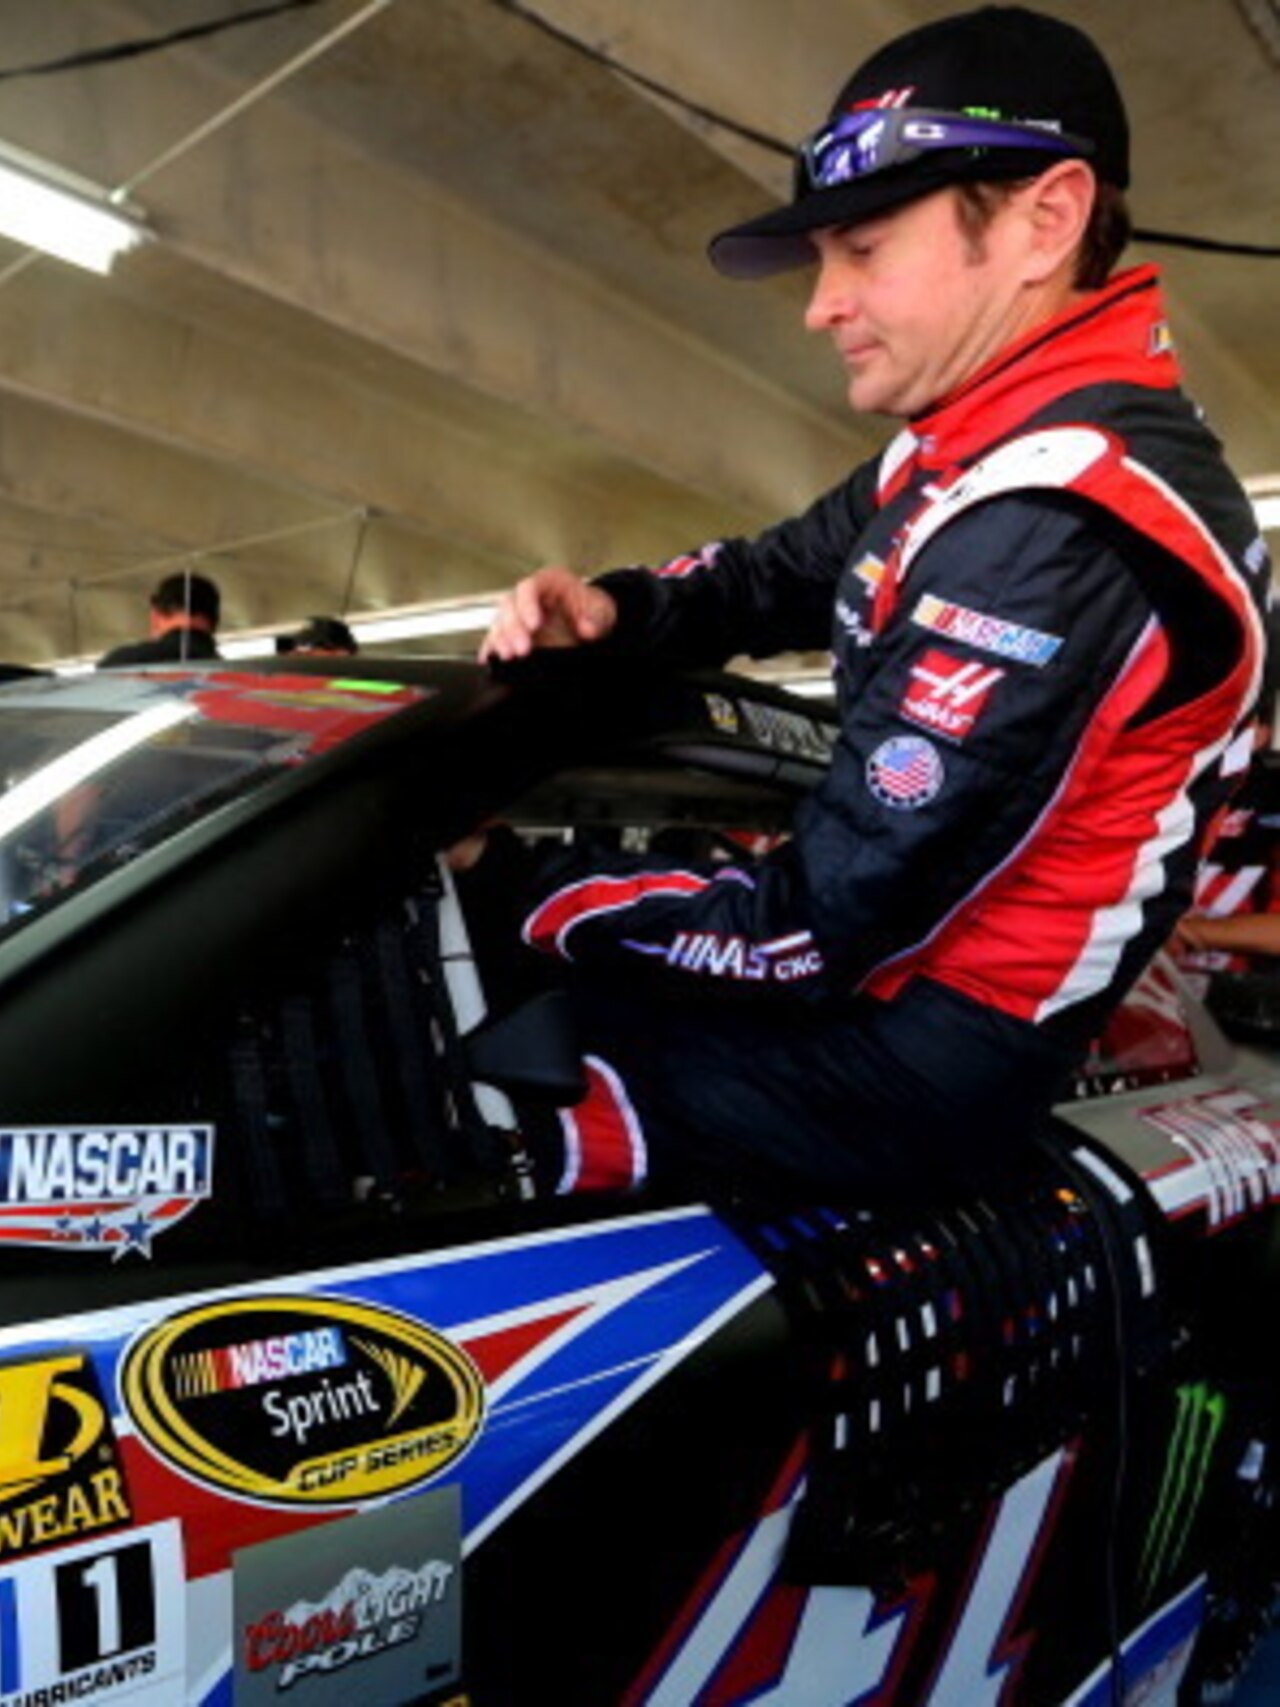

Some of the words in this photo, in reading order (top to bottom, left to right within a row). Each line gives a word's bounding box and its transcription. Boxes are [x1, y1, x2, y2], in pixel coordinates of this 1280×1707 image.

[8, 1130, 199, 1200] NASCAR
[228, 1326, 344, 1388] NASCAR
[261, 1371, 381, 1444] Sprint
[297, 1457, 357, 1492] CUP
[81, 1552, 122, 1658] 1
[0, 1649, 157, 1707] UBRICANTS
